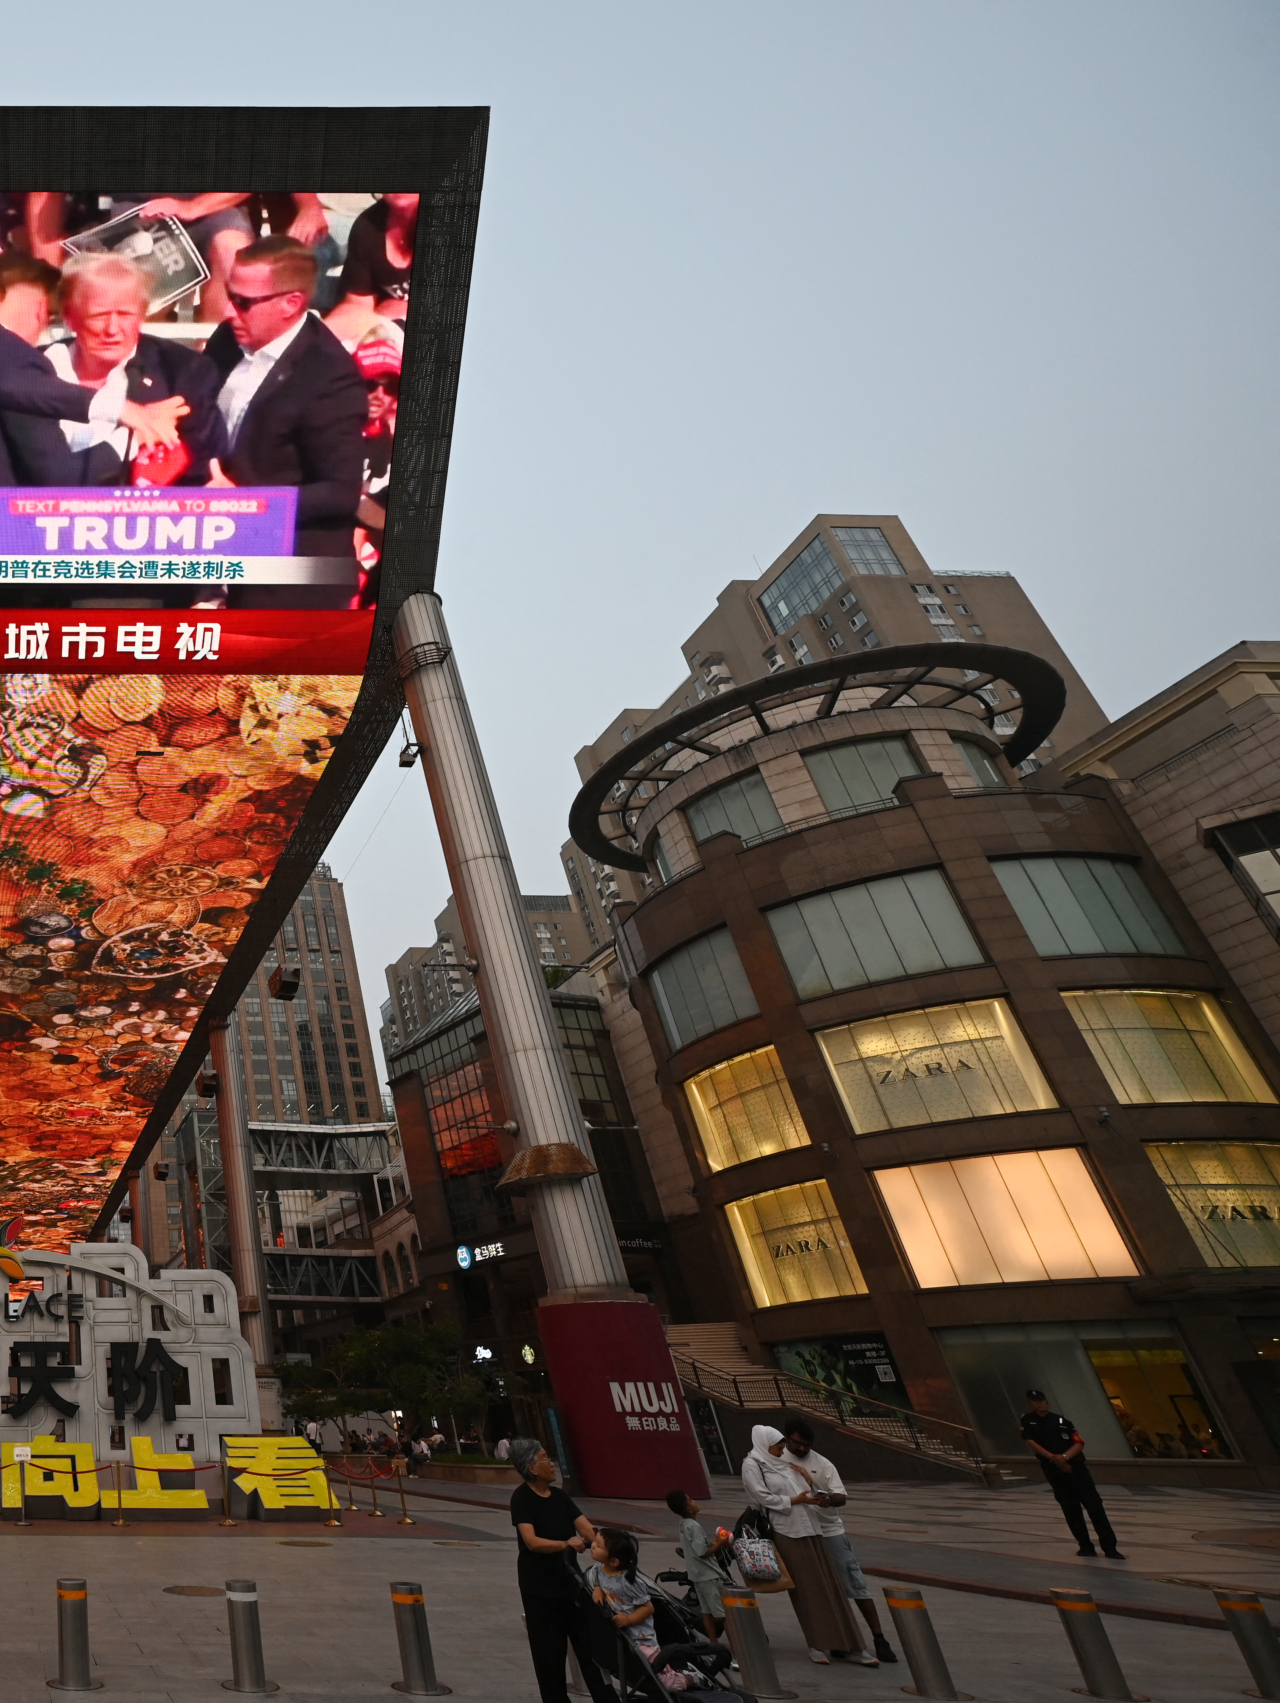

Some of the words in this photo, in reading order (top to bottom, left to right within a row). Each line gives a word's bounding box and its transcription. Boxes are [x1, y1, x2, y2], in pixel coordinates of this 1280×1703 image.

[16, 501, 56, 513] TEXT
[59, 500, 180, 514] PENNSYLVANIA
[184, 501, 205, 513] TO
[35, 516, 236, 550] TRUMP
[876, 1058, 976, 1085] ZARA
[474, 1242, 506, 1262] 盒马鲜生
[773, 1236, 832, 1260] ZARA
[609, 1382, 680, 1414] MUJI
[625, 1415, 681, 1432] 無印良品
